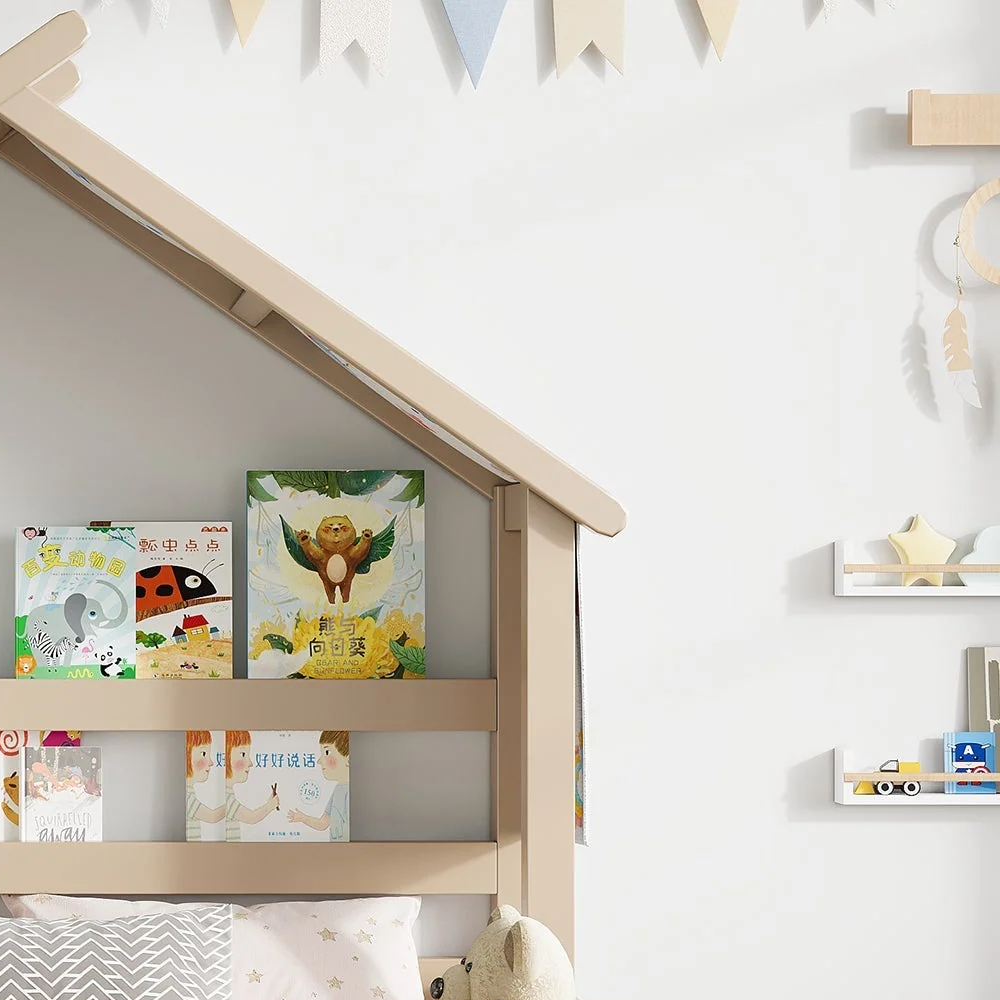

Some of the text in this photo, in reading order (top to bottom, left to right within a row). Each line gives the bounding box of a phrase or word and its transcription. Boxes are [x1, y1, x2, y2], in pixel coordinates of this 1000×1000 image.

[138, 538, 221, 553] 瓢虫点点
[21, 543, 126, 578] 百变动物园
[318, 616, 355, 636] 熊与
[309, 636, 366, 657] 向日葵
[963, 744, 975, 755] A
[255, 752, 316, 768] 好好说话
